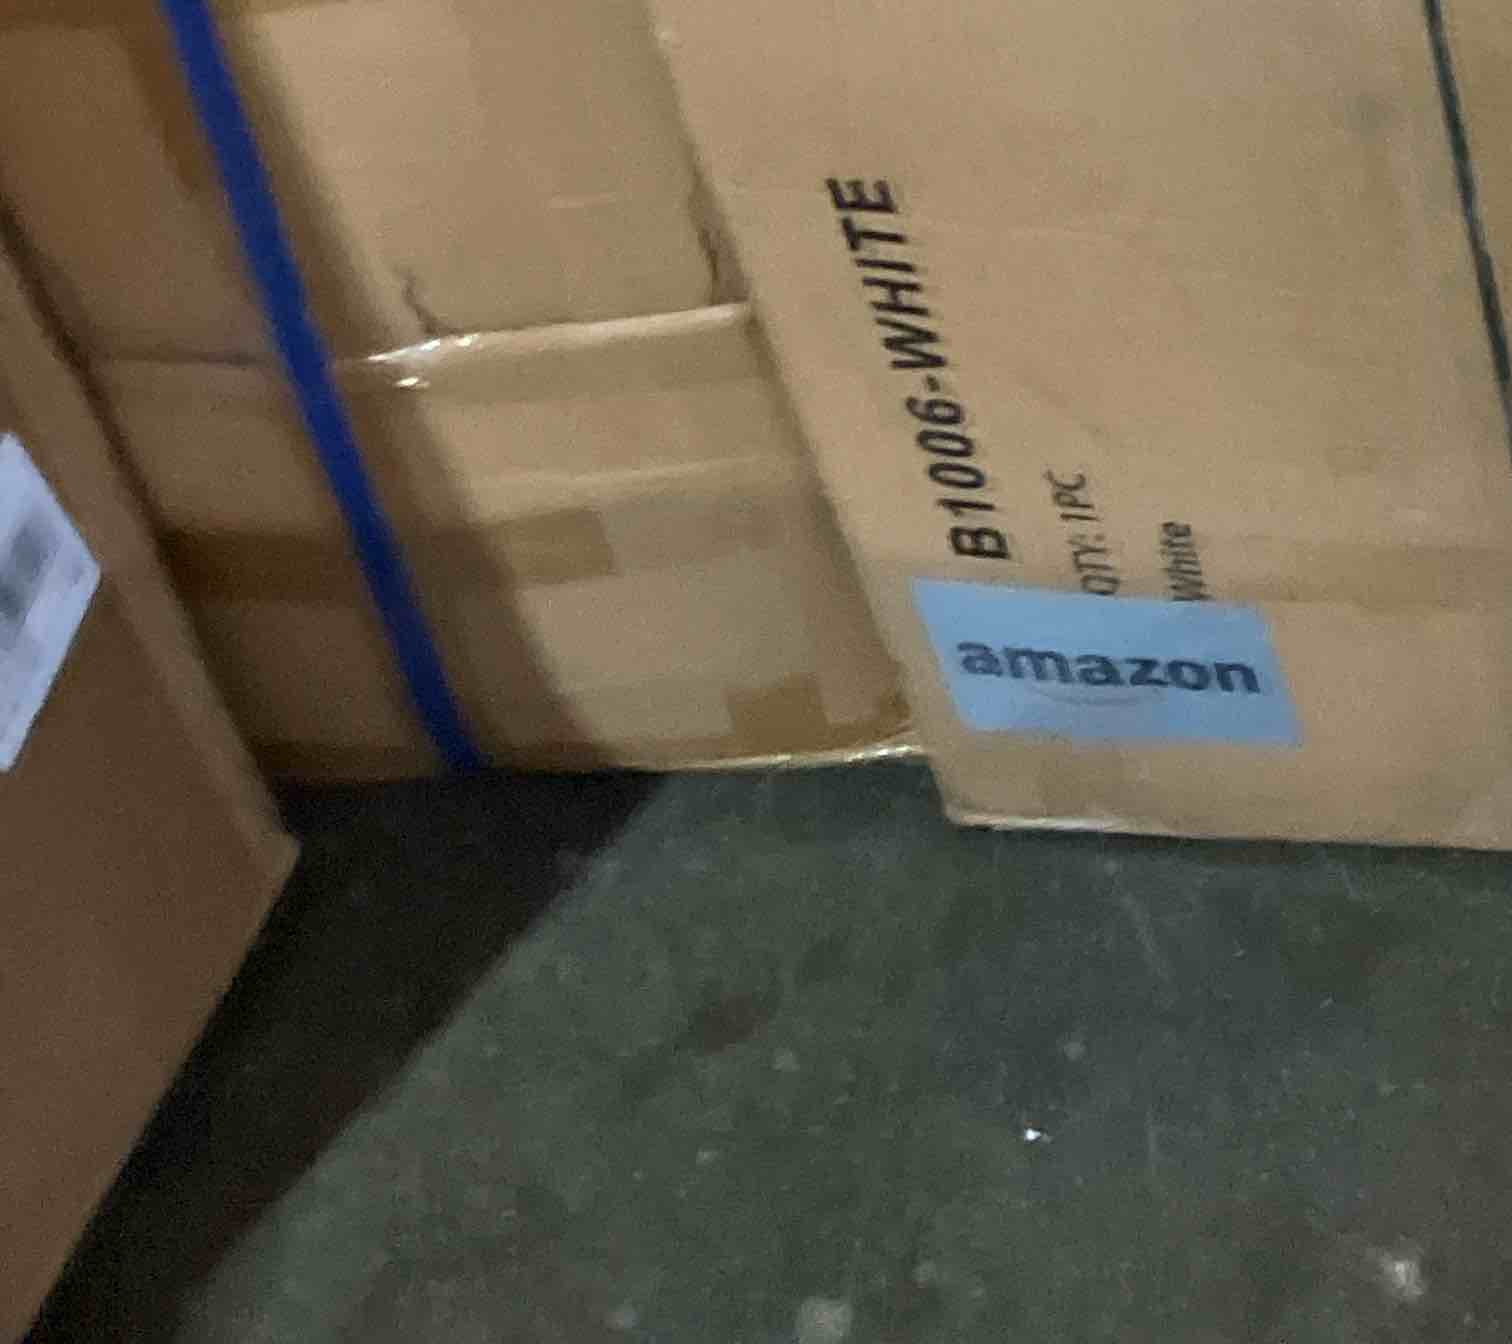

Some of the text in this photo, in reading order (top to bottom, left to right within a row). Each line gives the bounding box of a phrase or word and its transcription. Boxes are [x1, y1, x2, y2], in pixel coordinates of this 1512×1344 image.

[826, 175, 1012, 562] B1006-WHITE
[1043, 469, 1105, 523] 1PC
[956, 641, 1262, 697] amazon
